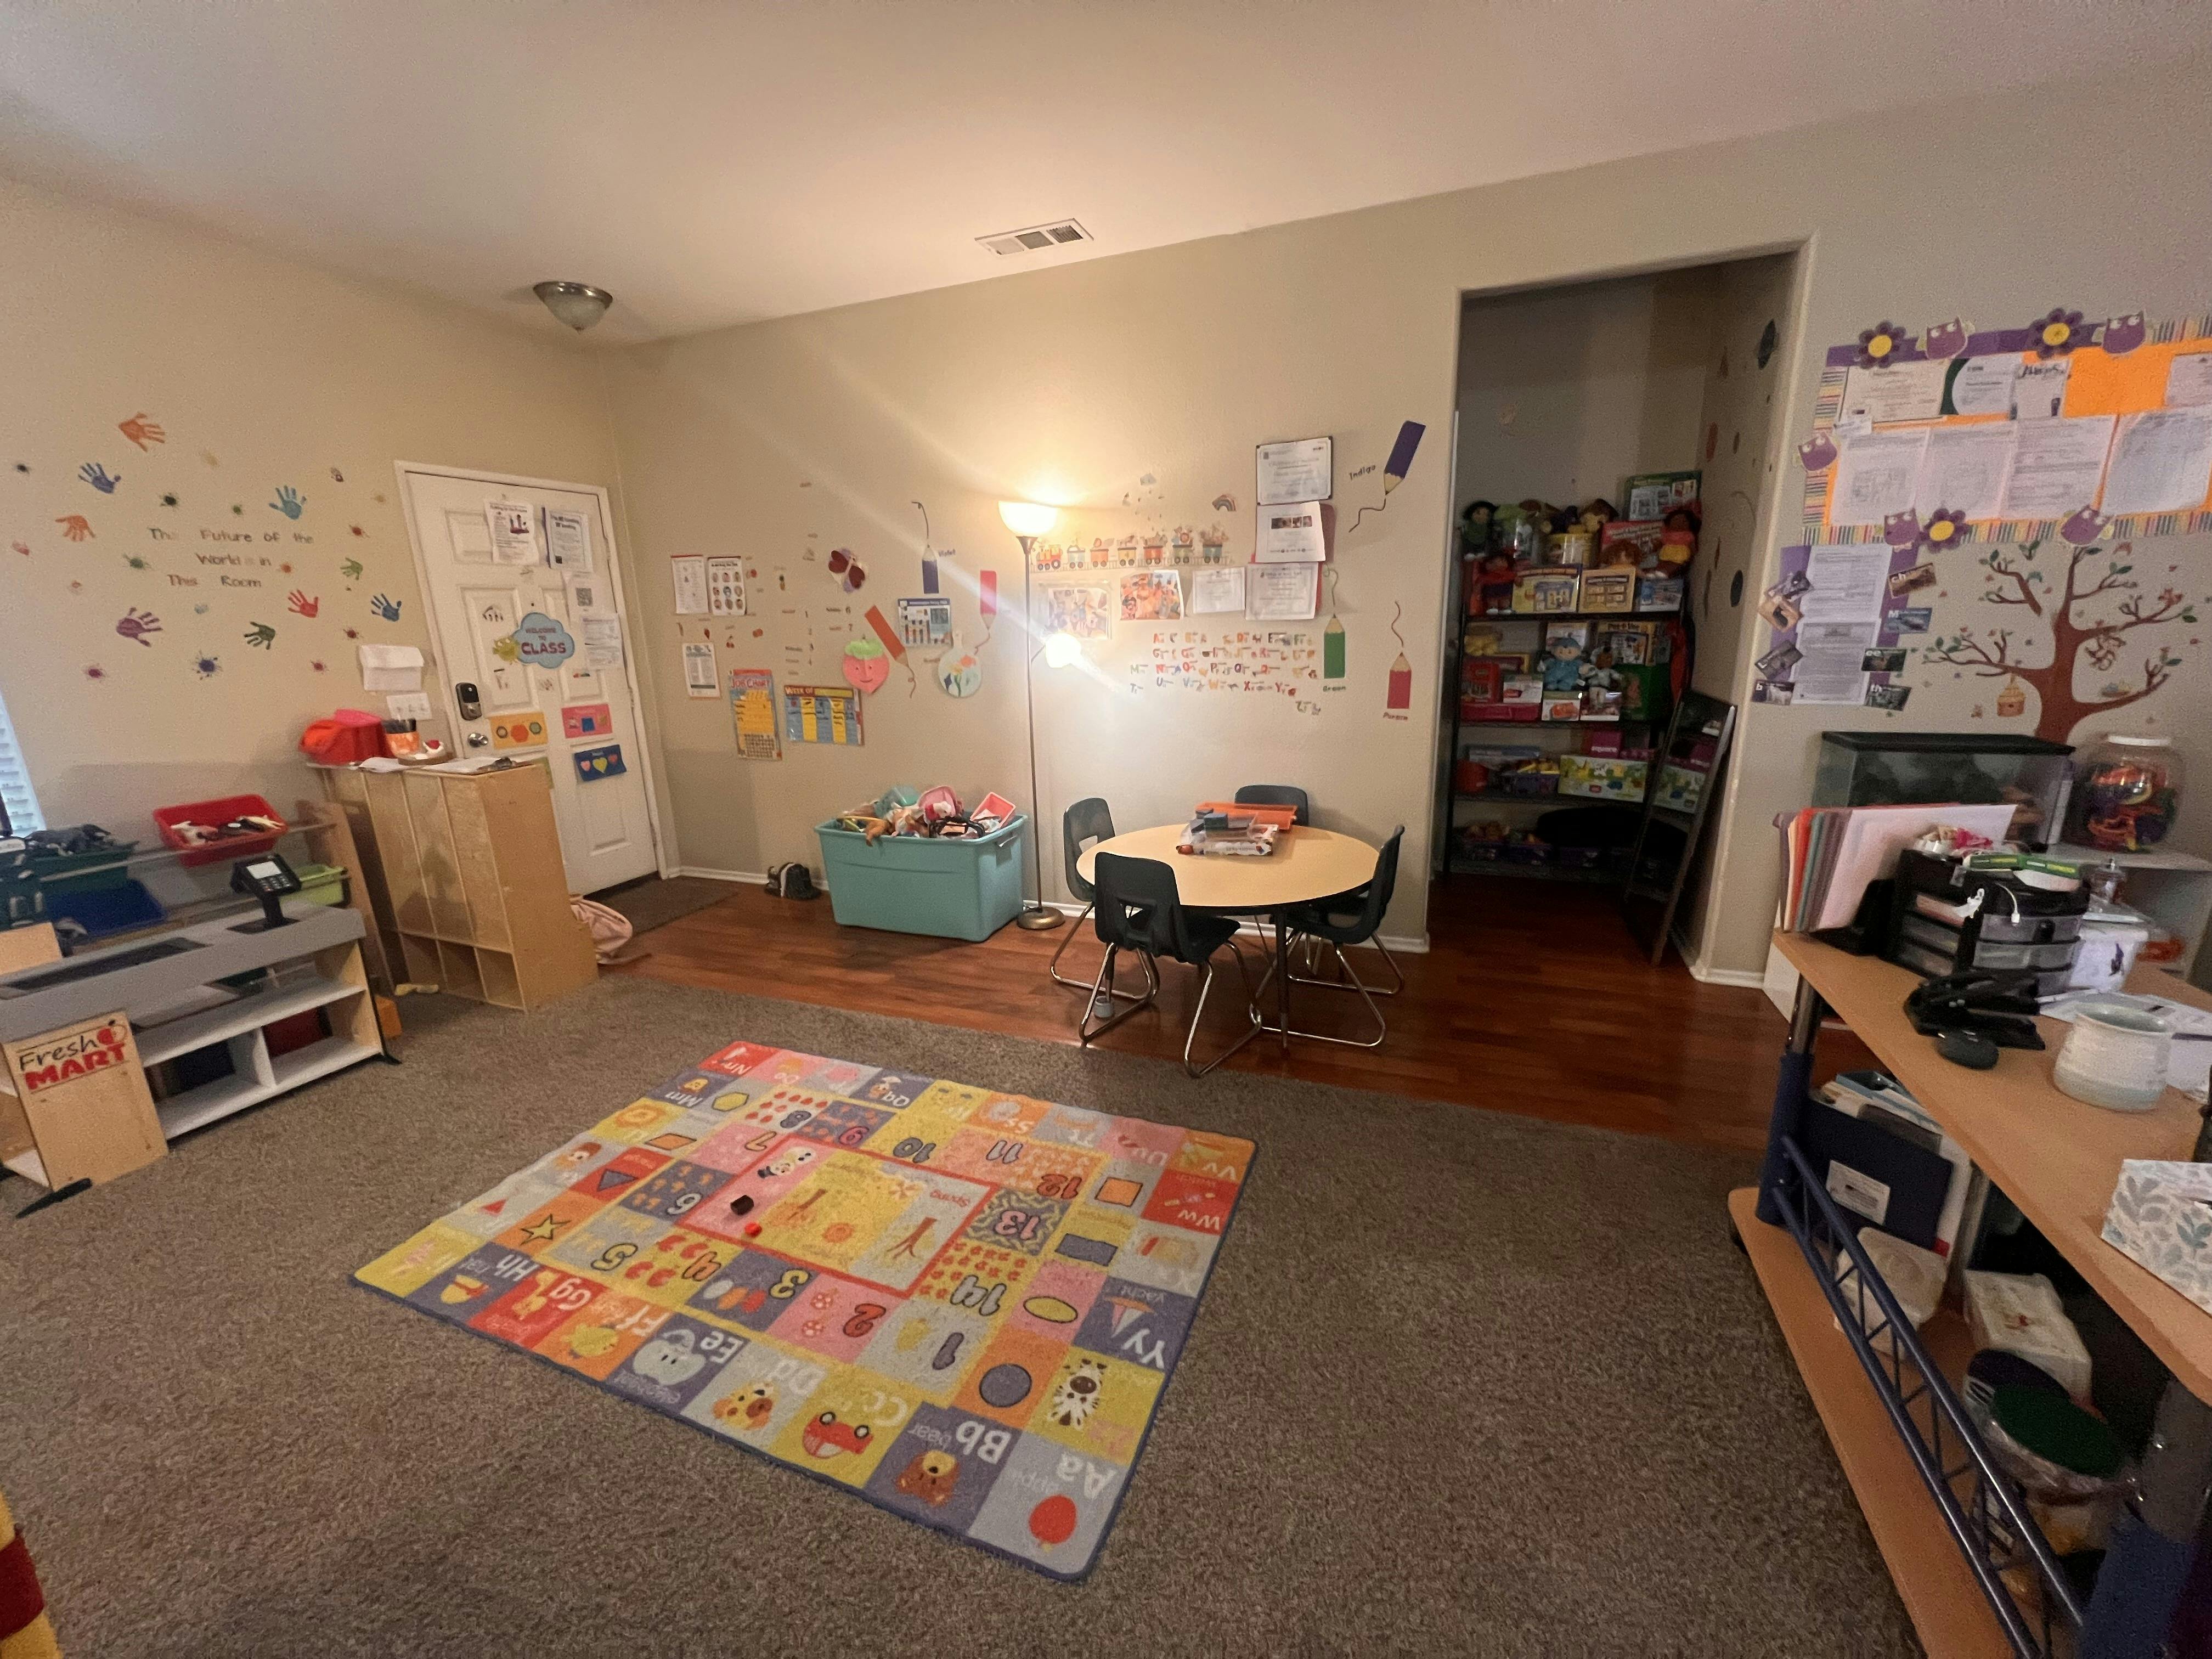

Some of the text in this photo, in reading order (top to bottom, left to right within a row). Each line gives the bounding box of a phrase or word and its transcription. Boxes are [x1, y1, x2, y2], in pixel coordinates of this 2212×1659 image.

[1349, 465, 1376, 481] Indigo
[199, 529, 252, 543] Future
[264, 531, 280, 543] of
[294, 532, 314, 544] the
[259, 556, 272, 566] in
[938, 548, 956, 557] Violet
[167, 574, 262, 588] This Room
[521, 642, 566, 655] CLASS
[731, 678, 746, 688] JOB
[19, 1035, 99, 1070] Fresh
[24, 1042, 125, 1090] MART
[665, 1092, 703, 1107] Mm
[882, 1091, 910, 1107] Qq
[780, 1110, 811, 1129] 8
[744, 1131, 777, 1151] 7
[839, 1126, 870, 1146] 9
[893, 1137, 936, 1163] 10
[986, 1140, 1023, 1164] 11
[1204, 1163, 1237, 1181] Vv
[1037, 1174, 1082, 1199] 12
[667, 1193, 702, 1215] 6
[995, 1210, 1041, 1240] 13
[1178, 1210, 1220, 1229] Ww
[494, 1254, 540, 1282] Hh
[590, 1243, 639, 1271] 5
[681, 1251, 722, 1282] 4
[549, 1278, 592, 1311] Gg
[769, 1268, 810, 1299] 3
[950, 1275, 1007, 1316] 14
[616, 1304, 671, 1337] Ff
[843, 1303, 887, 1338] 2
[699, 1331, 744, 1364] Ee
[932, 1332, 964, 1370] 1
[1121, 1328, 1165, 1369] Yy
[907, 1423, 952, 1451] bear
[955, 1420, 1011, 1464] Bb
[1056, 1451, 1118, 1499] Aa
